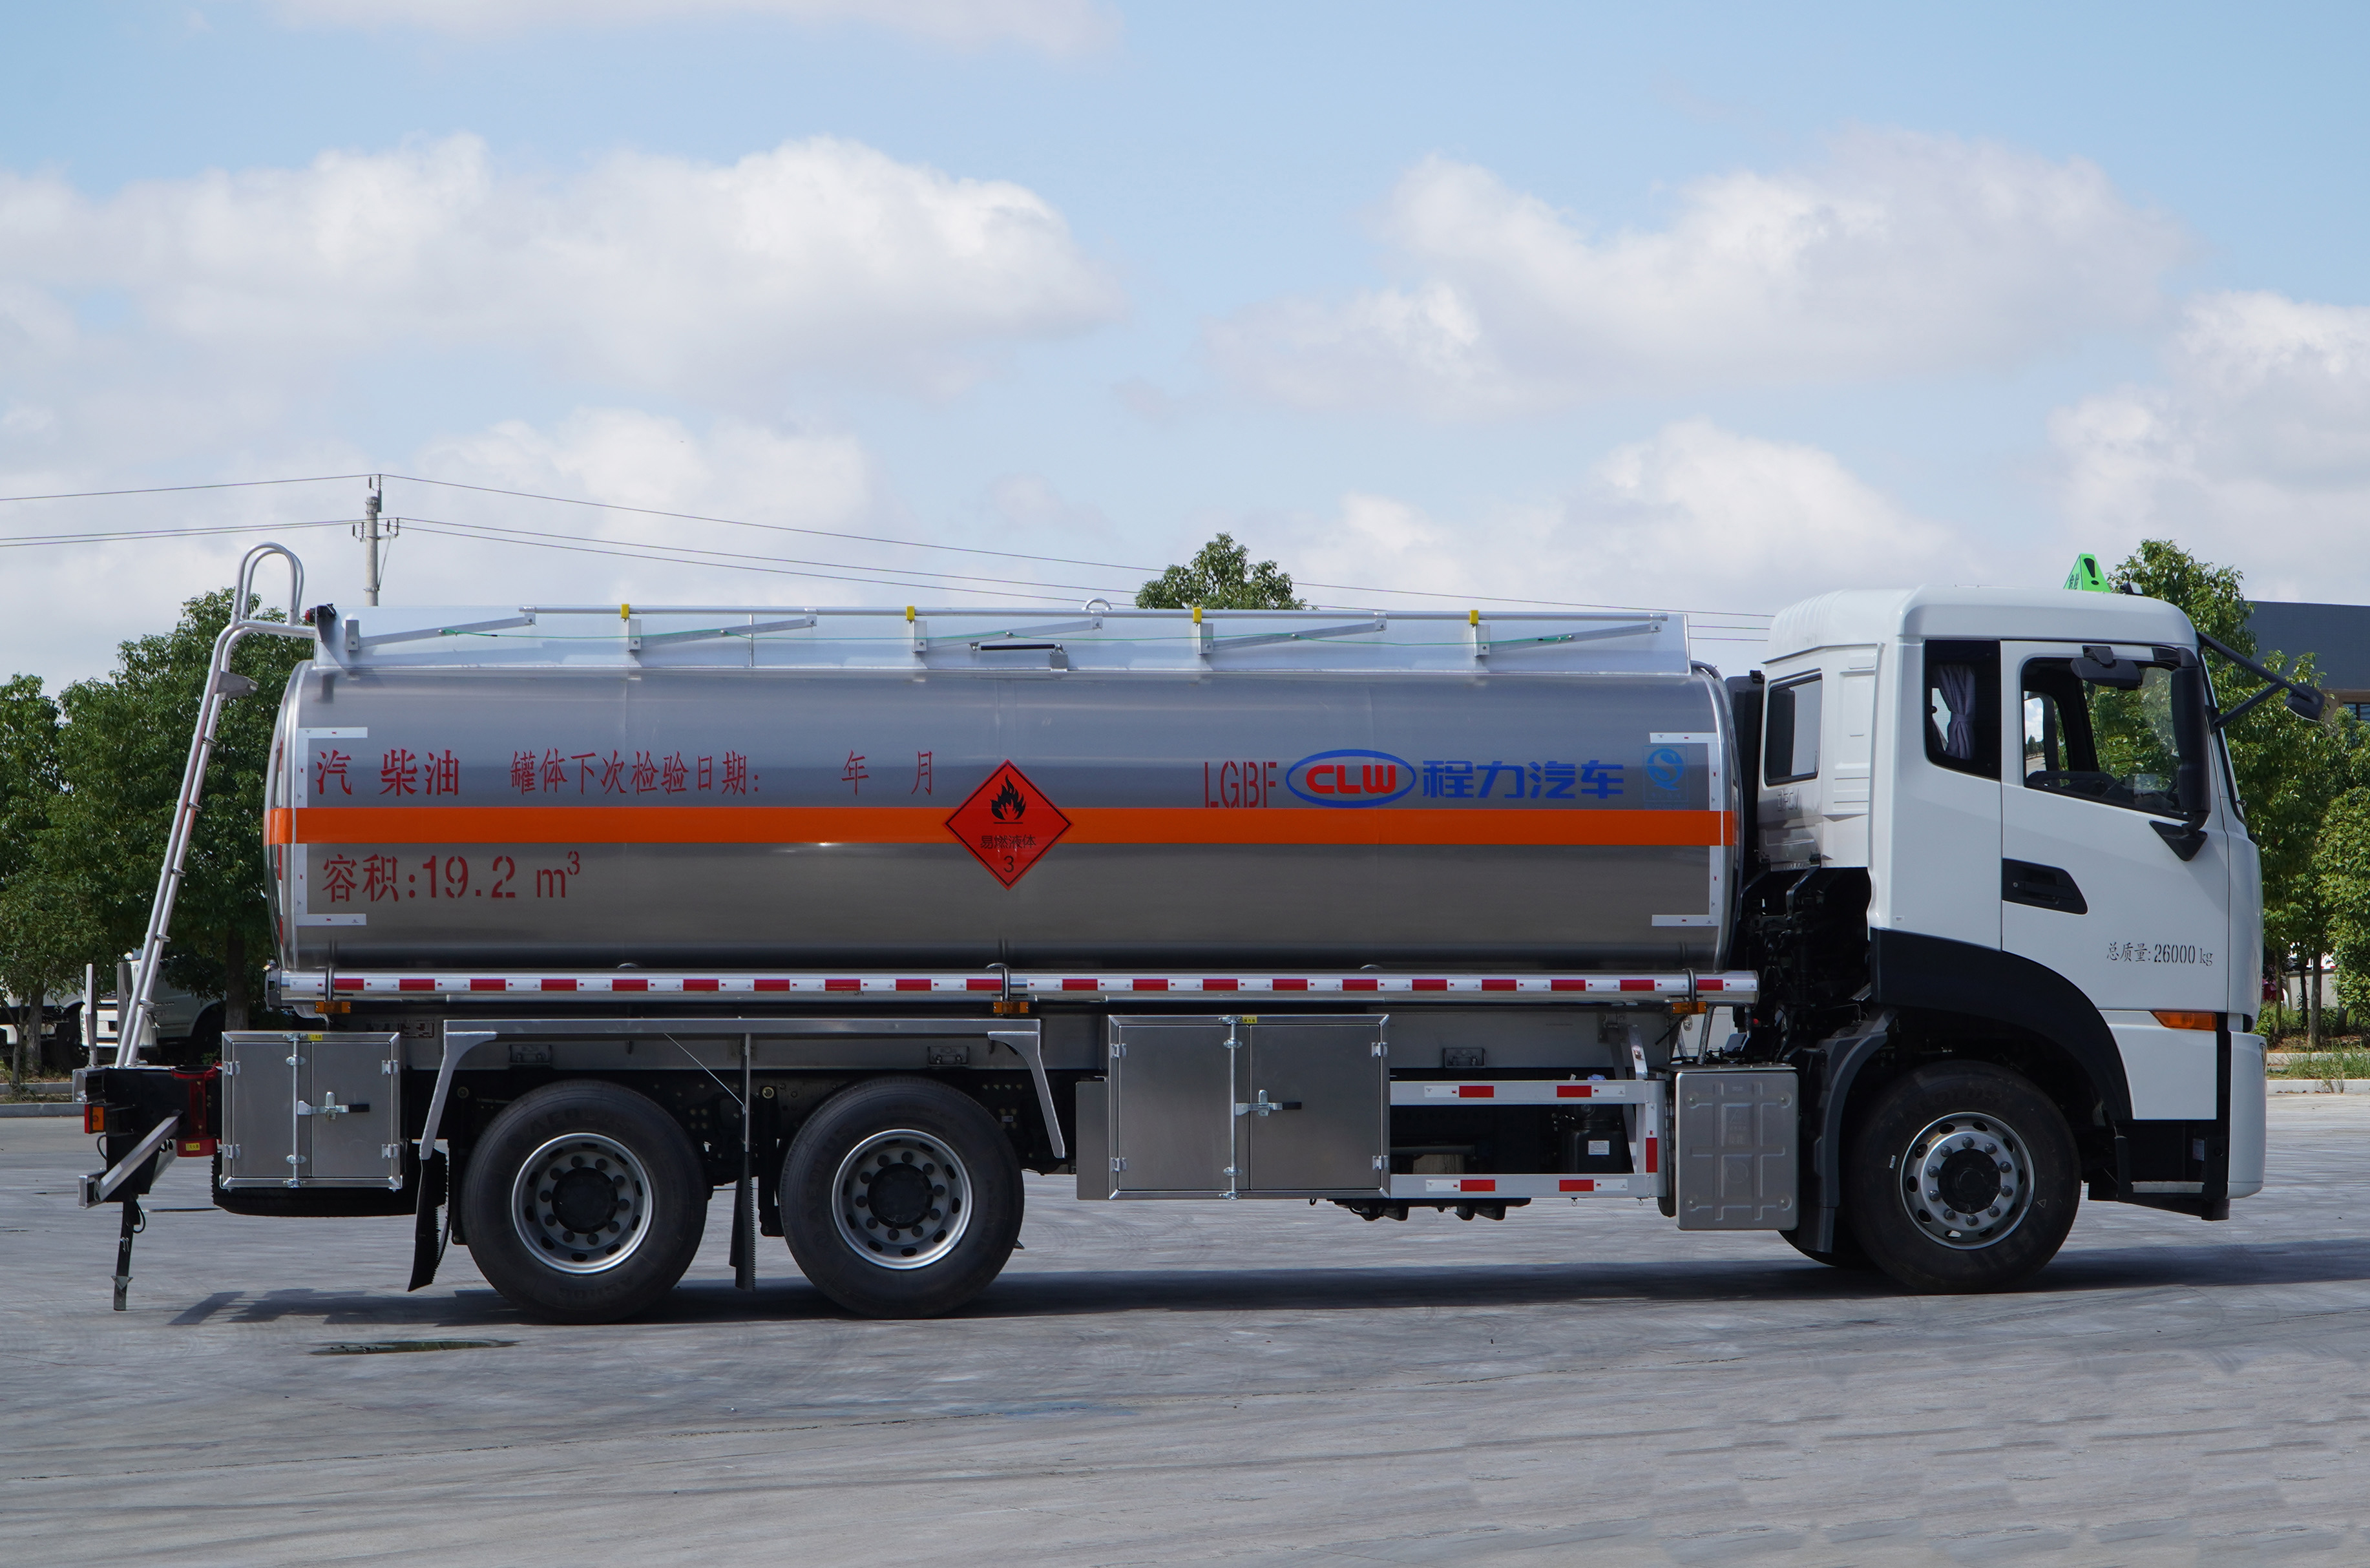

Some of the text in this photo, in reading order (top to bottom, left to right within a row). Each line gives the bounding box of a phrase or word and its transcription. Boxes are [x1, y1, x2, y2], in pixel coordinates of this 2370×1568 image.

[316, 749, 459, 797] 汽 柴油
[841, 750, 933, 795] 年 月
[1204, 761, 1277, 808] LGBF
[1305, 764, 1397, 795] CLW
[1422, 758, 1625, 799] 程力汽车
[980, 835, 1036, 849] 易燃液体
[1003, 855, 1014, 873] 3
[2199, 948, 2213, 967] kg
